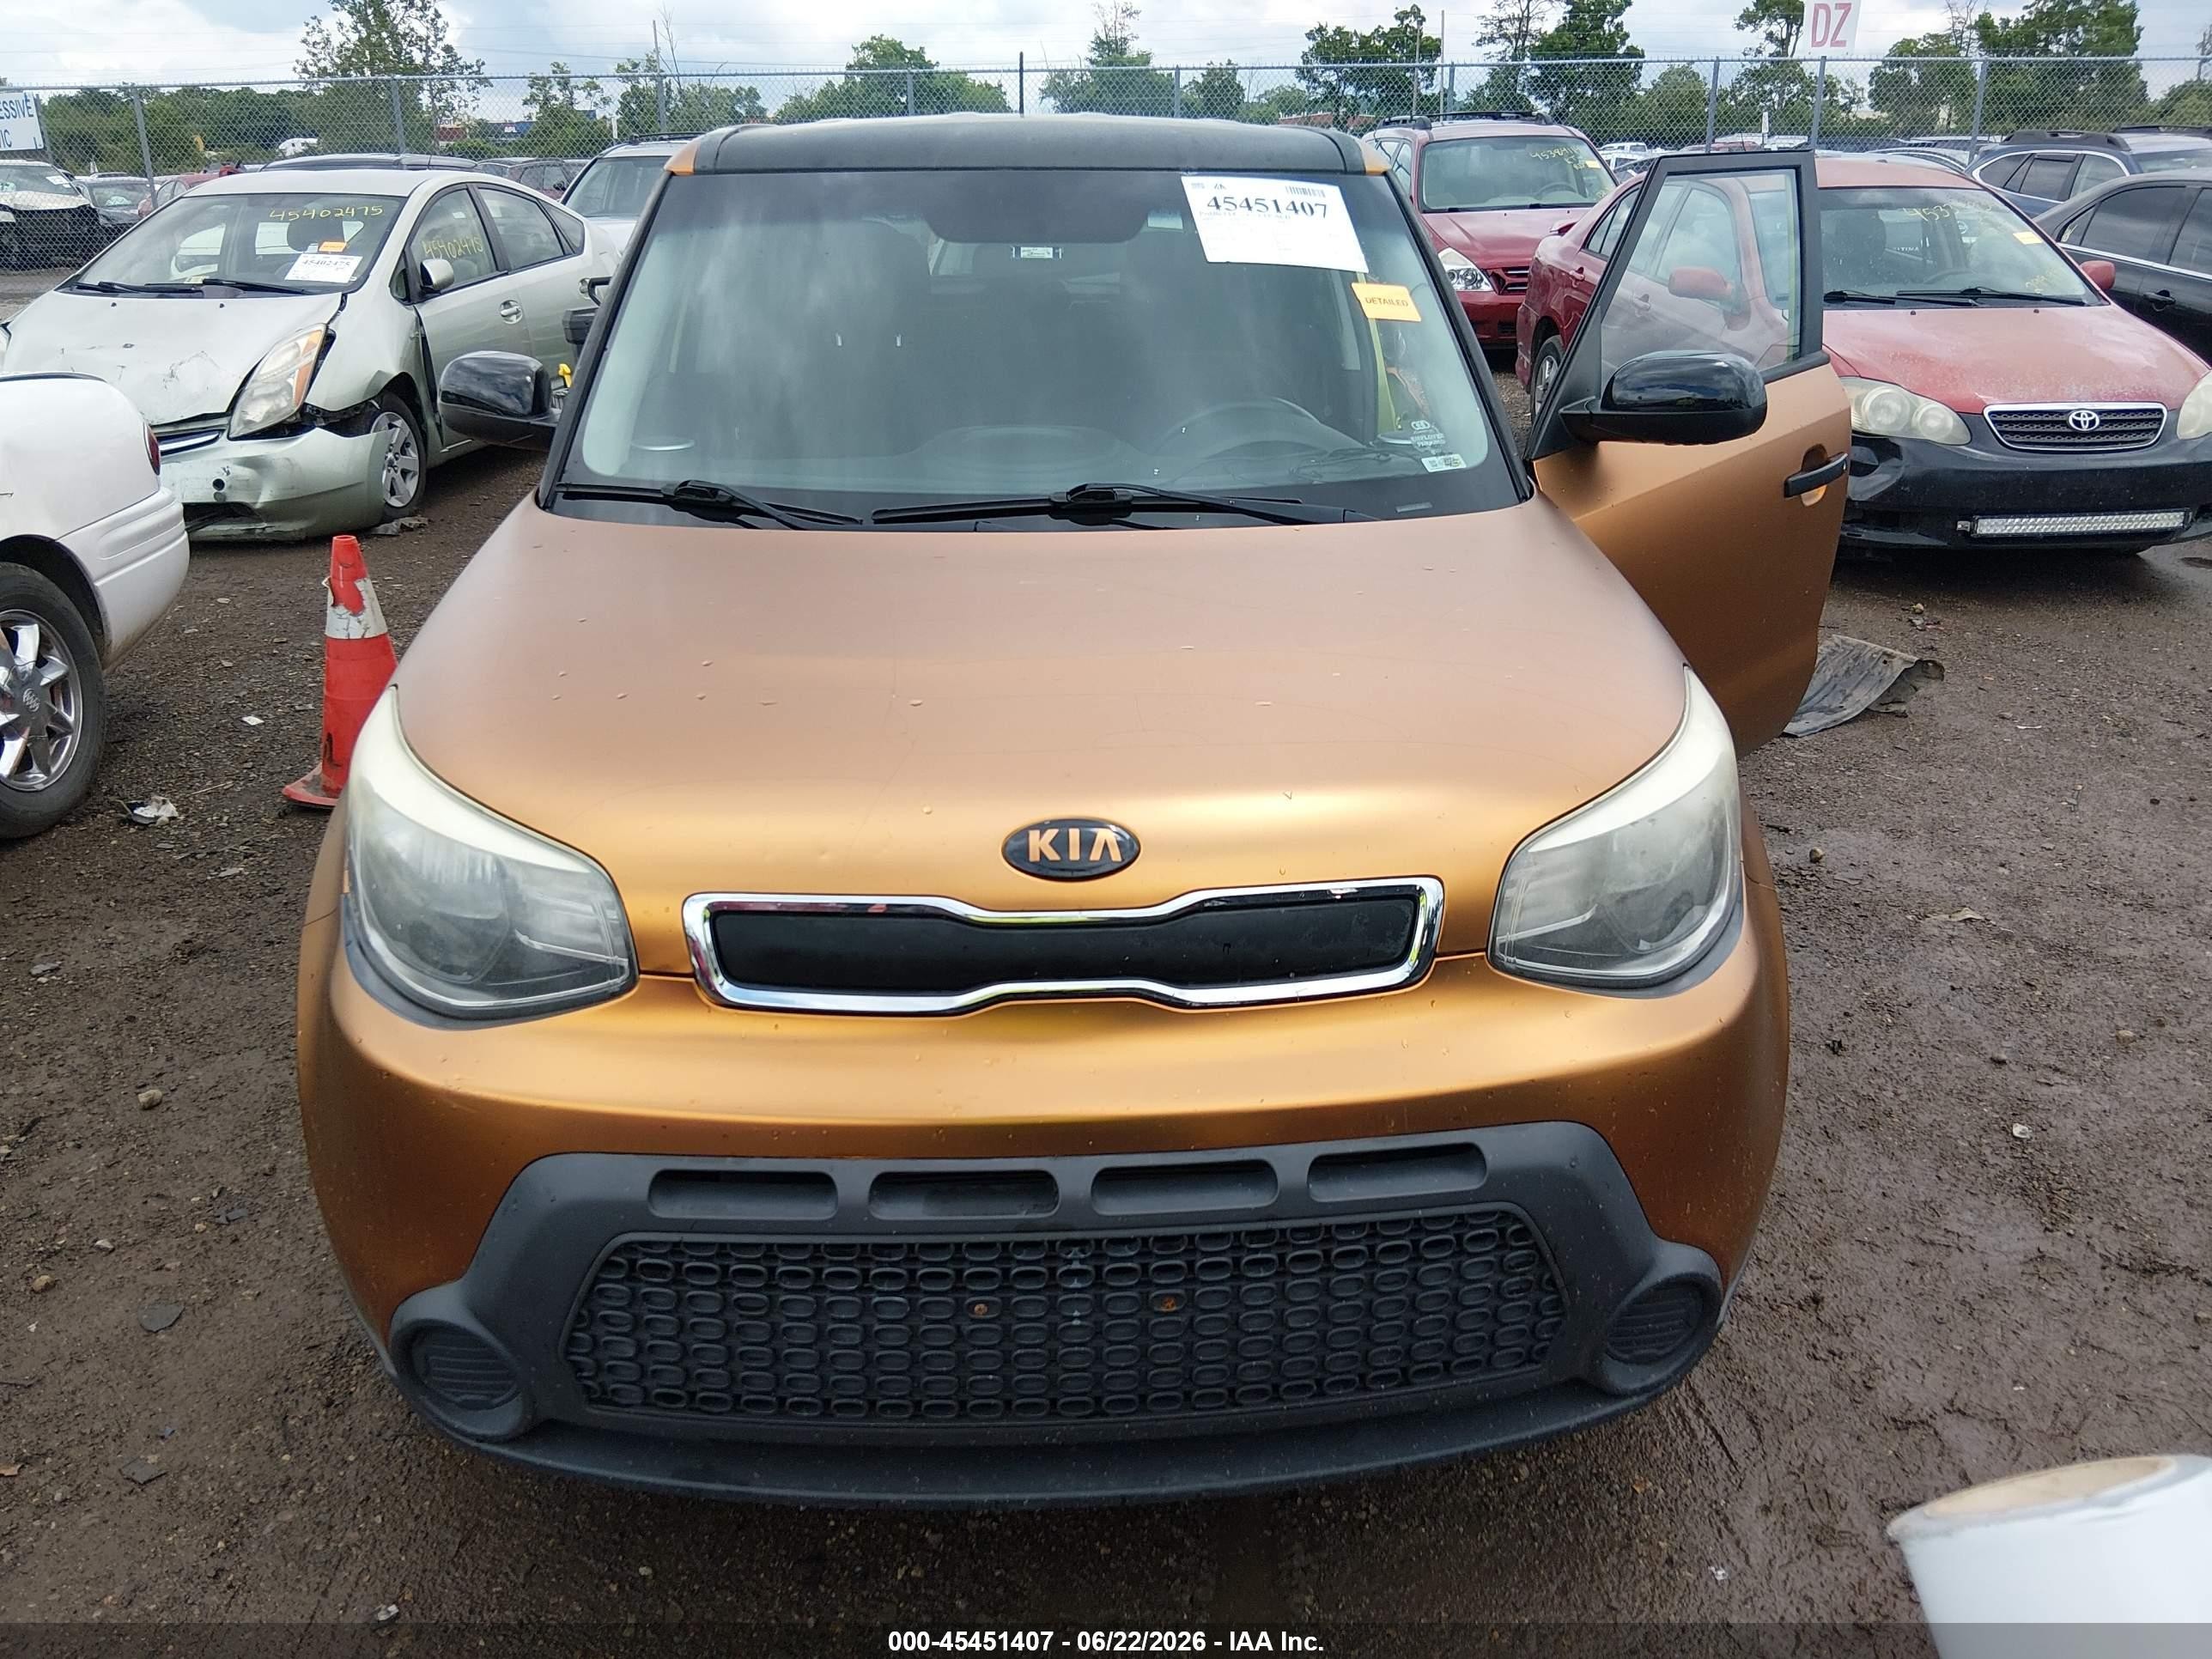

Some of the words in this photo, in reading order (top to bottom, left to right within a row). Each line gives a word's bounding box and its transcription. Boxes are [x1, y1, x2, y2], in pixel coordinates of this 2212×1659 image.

[1811, 3, 1852, 47] DZ
[269, 205, 384, 221] 45402475
[1207, 196, 1327, 219] 45451407
[1365, 297, 1408, 307] DETAILED
[1029, 828, 1122, 862] KIA
